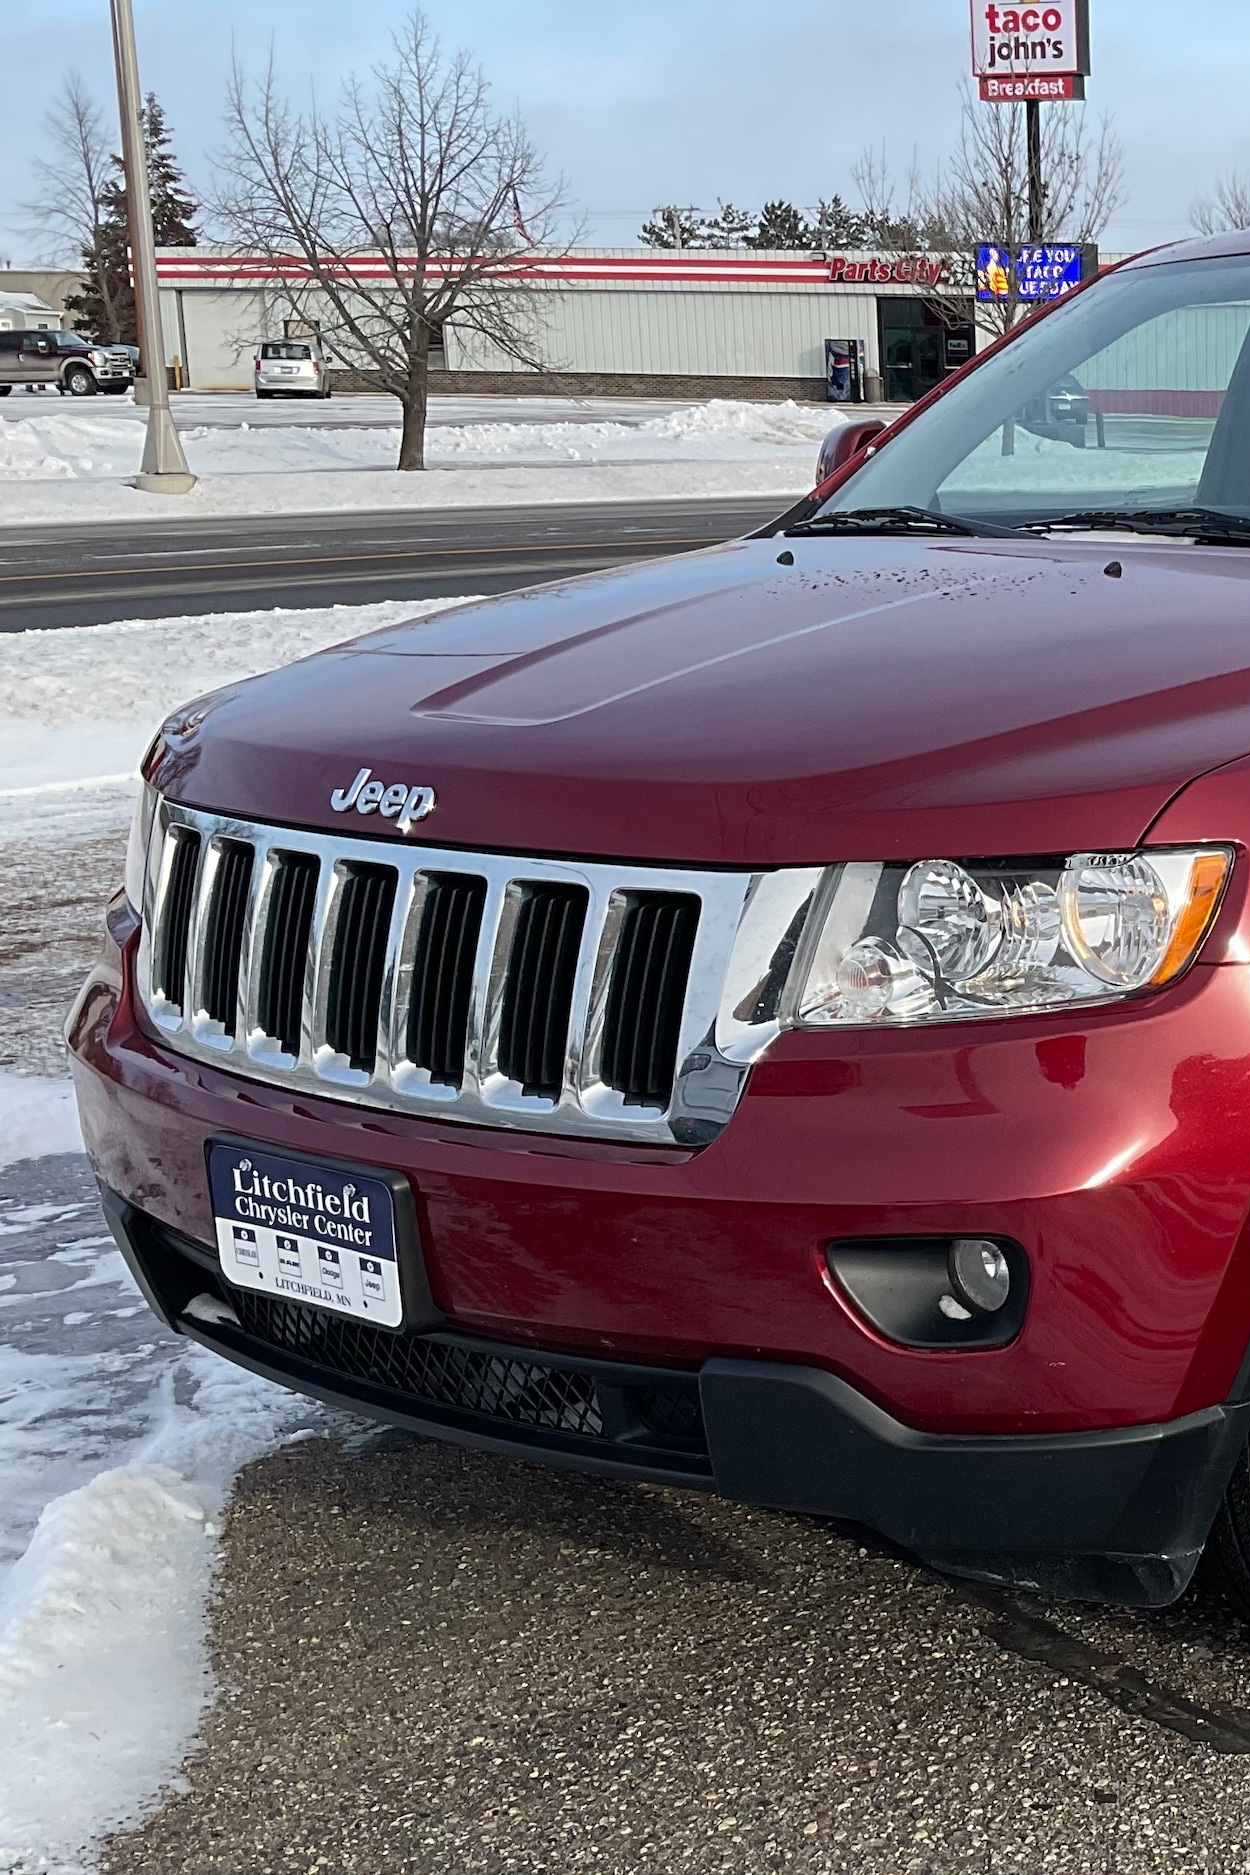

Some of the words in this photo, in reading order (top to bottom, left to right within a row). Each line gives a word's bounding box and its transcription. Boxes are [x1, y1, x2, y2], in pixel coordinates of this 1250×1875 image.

[985, 4, 1062, 34] taco
[988, 36, 1063, 68] john's
[987, 78, 1064, 97] Breakfast
[1046, 249, 1076, 263] YOU
[829, 256, 892, 282] Parts
[895, 257, 942, 288] City
[330, 767, 436, 831] Jeep
[232, 1167, 371, 1224] Litchfield
[235, 1195, 309, 1230] Chrysler
[313, 1214, 373, 1247] Center
[275, 1276, 334, 1303] LITCHFIELD,
[336, 1293, 352, 1307] MN
[364, 1279, 381, 1292] Jeep
